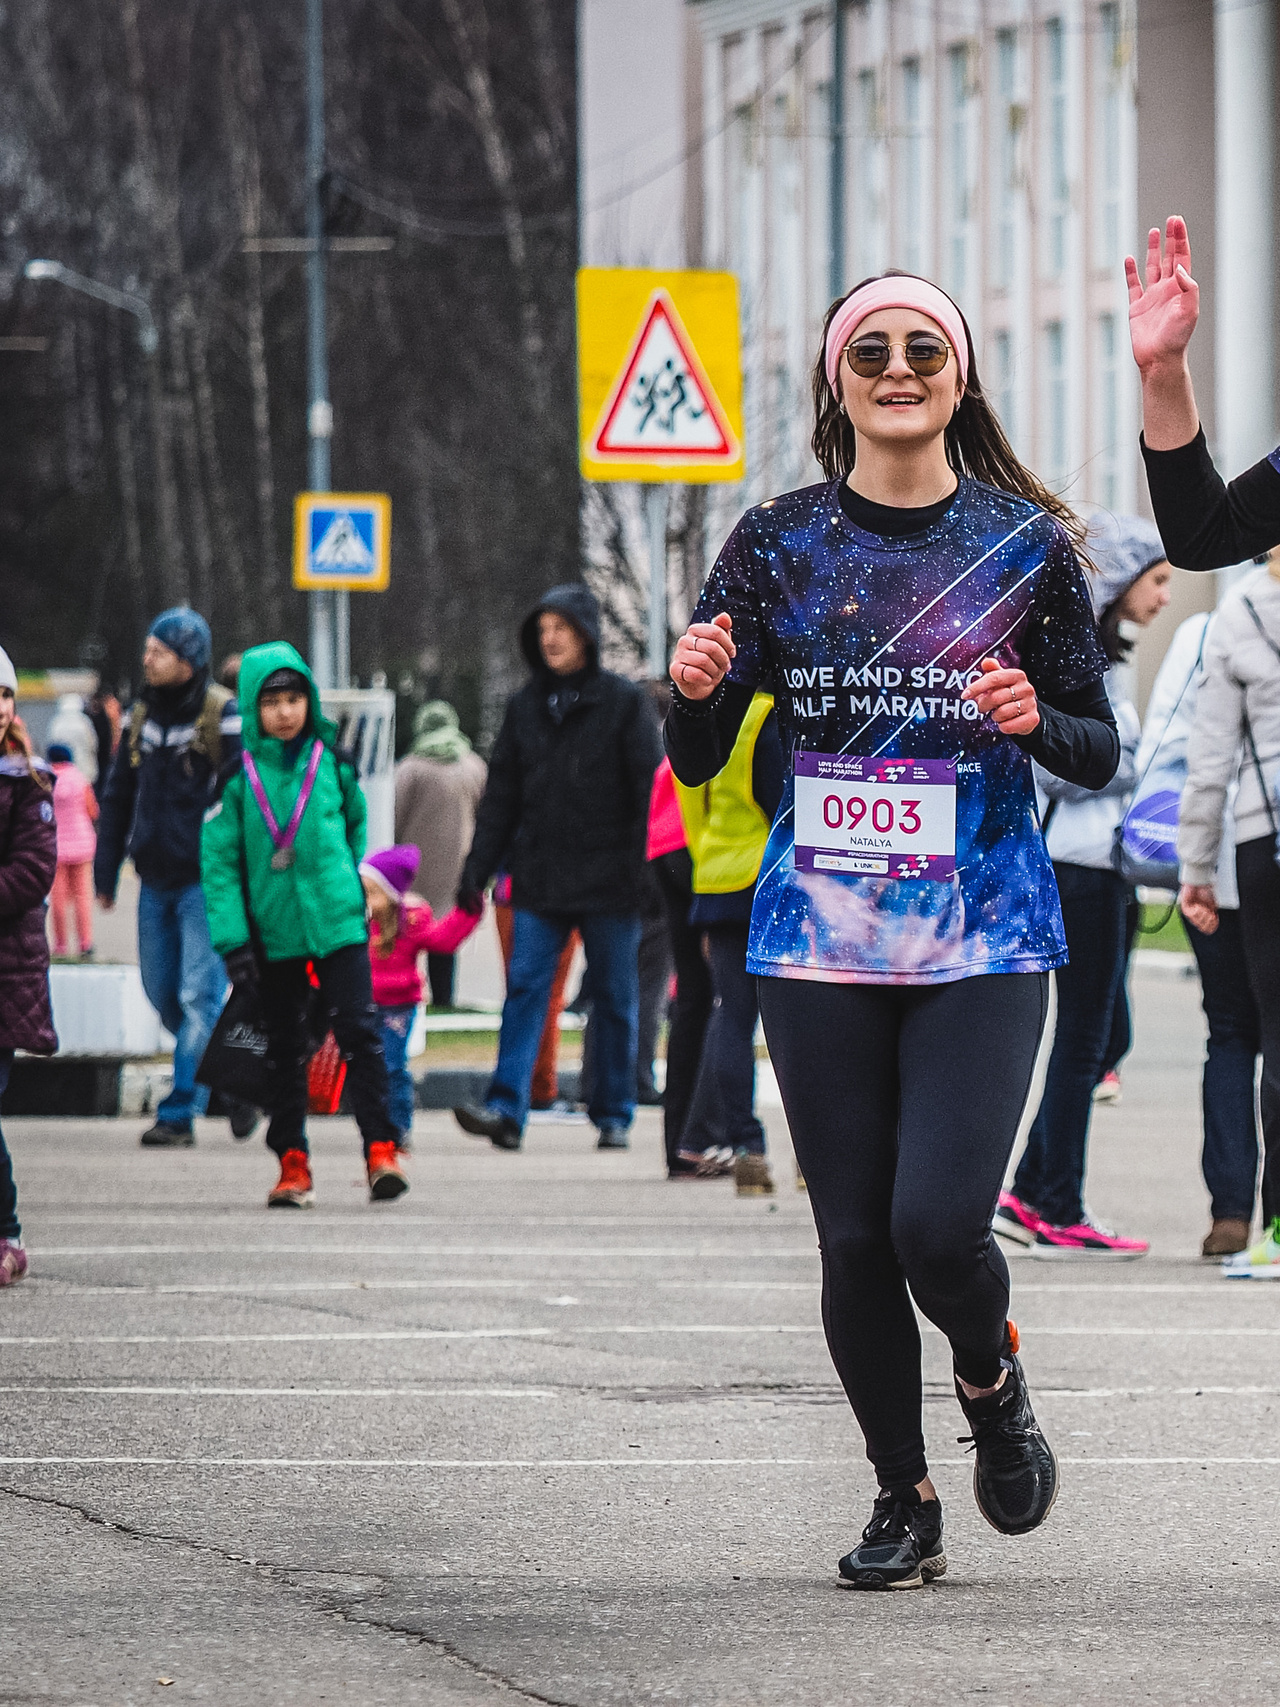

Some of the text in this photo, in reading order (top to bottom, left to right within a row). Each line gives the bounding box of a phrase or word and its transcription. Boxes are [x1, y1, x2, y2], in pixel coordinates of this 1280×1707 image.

[784, 666, 983, 690] LOVE AND SPAC
[792, 695, 984, 721] HALF MARATHO
[818, 760, 832, 768] LOVE
[844, 763, 863, 771] SPACE
[957, 762, 982, 774] PACE
[833, 768, 863, 776] MARATHON
[823, 794, 922, 835] 0903
[850, 837, 893, 848] NATALYA
